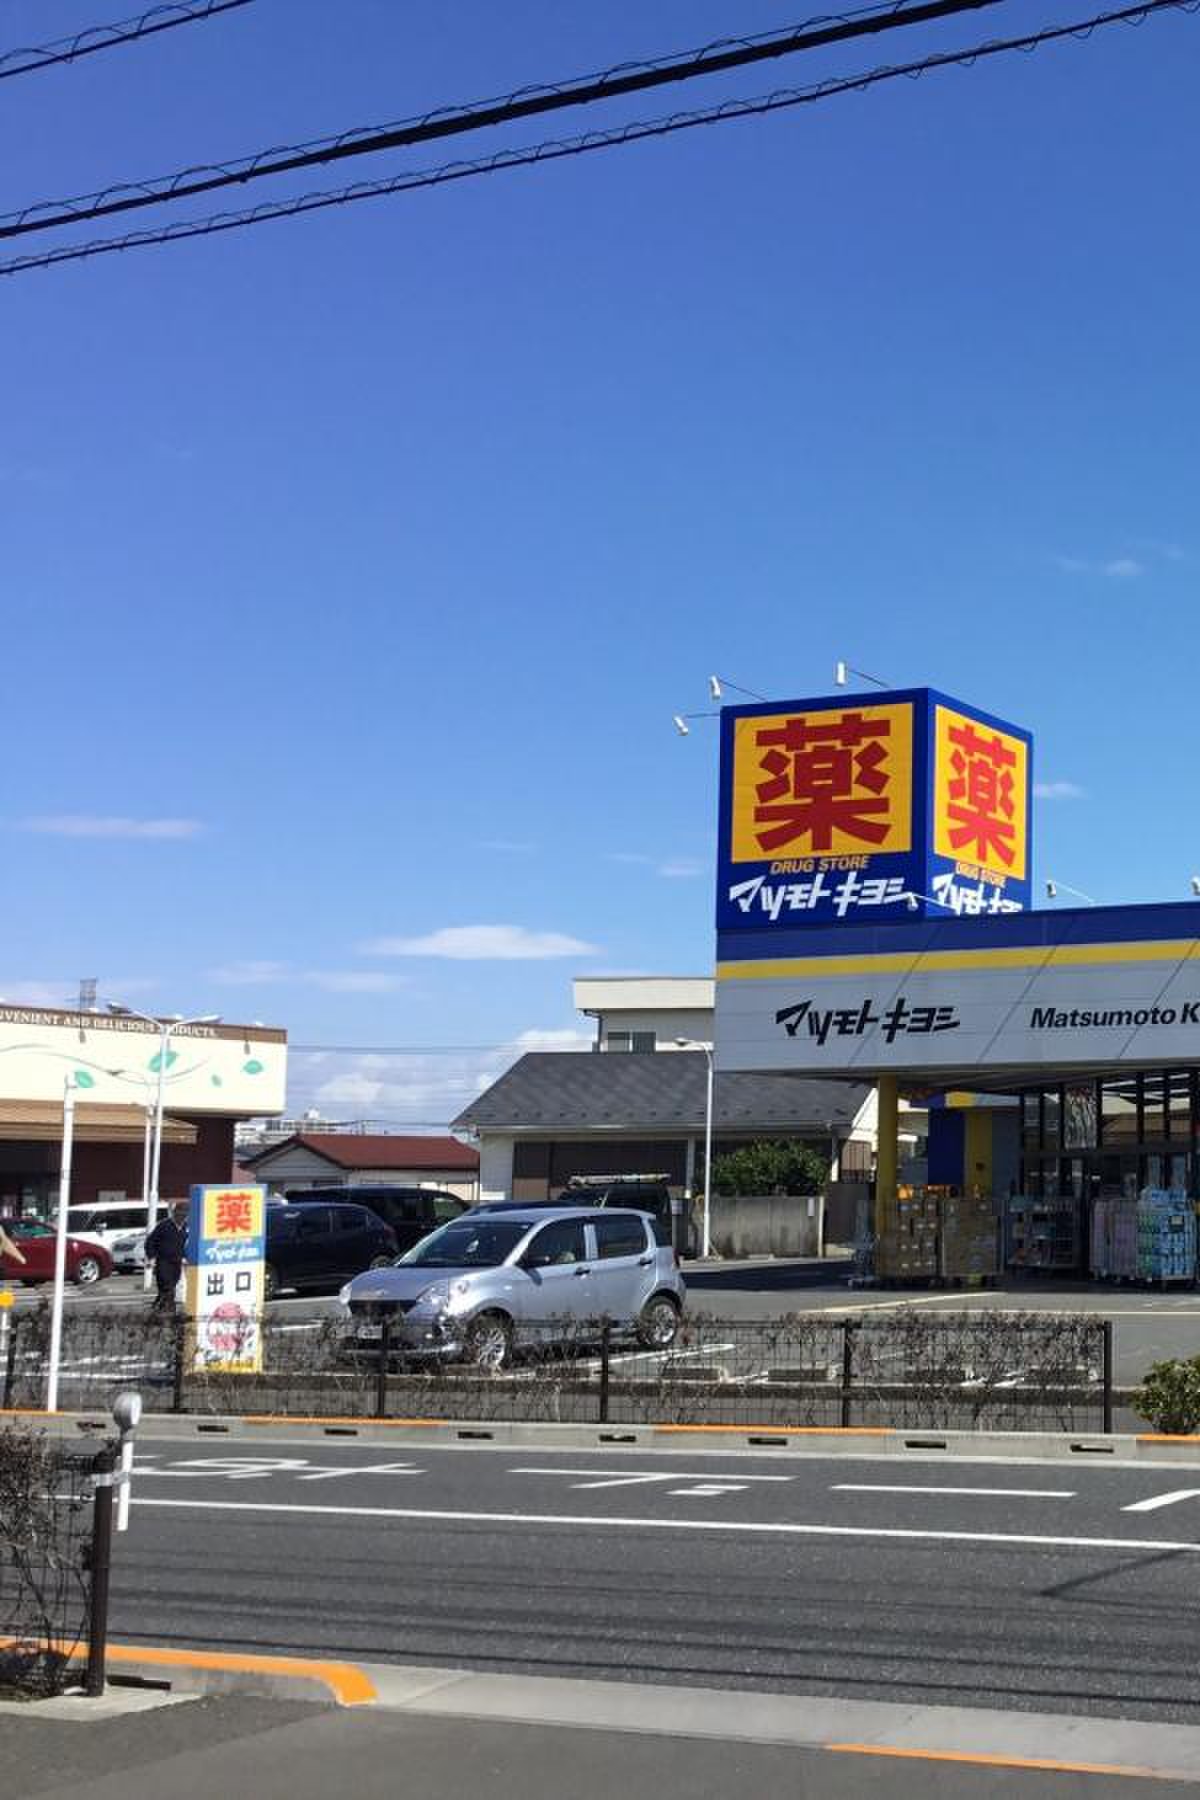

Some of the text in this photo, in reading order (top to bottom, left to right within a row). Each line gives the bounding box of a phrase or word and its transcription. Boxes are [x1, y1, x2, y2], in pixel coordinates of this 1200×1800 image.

[754, 713, 891, 851] 薬
[947, 724, 1017, 866] 薬
[770, 855, 870, 875] DRUG STORE
[729, 871, 906, 921] マツモトキヨシ
[775, 997, 961, 1046] マツモトキヨシ
[1030, 1006, 1176, 1029] Matsumoto
[216, 1193, 252, 1233] 薬
